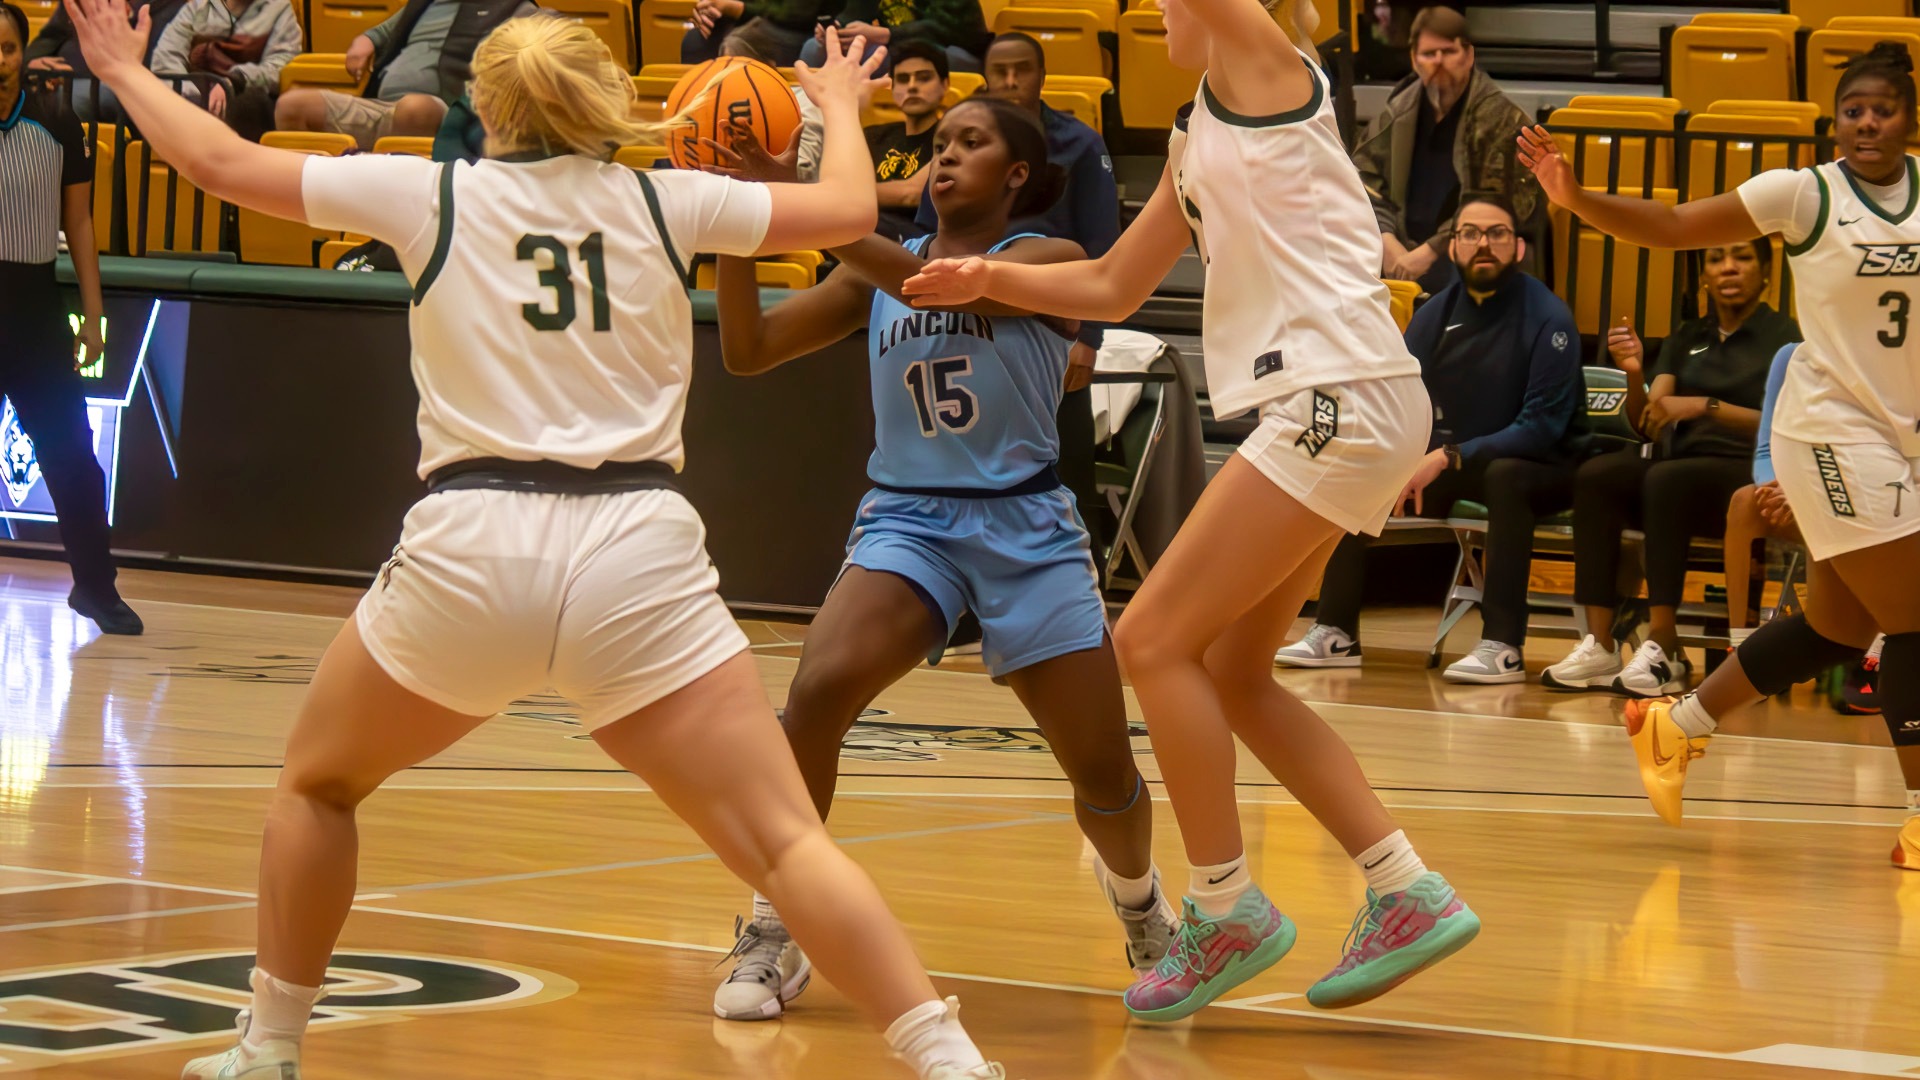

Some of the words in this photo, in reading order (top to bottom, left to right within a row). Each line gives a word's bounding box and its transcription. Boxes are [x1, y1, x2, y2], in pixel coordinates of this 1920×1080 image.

[516, 232, 611, 332] 31
[879, 311, 995, 358] LINCOLN
[1877, 290, 1911, 348] 3
[904, 355, 980, 438] 15
[1814, 448, 1854, 514] MINERS
